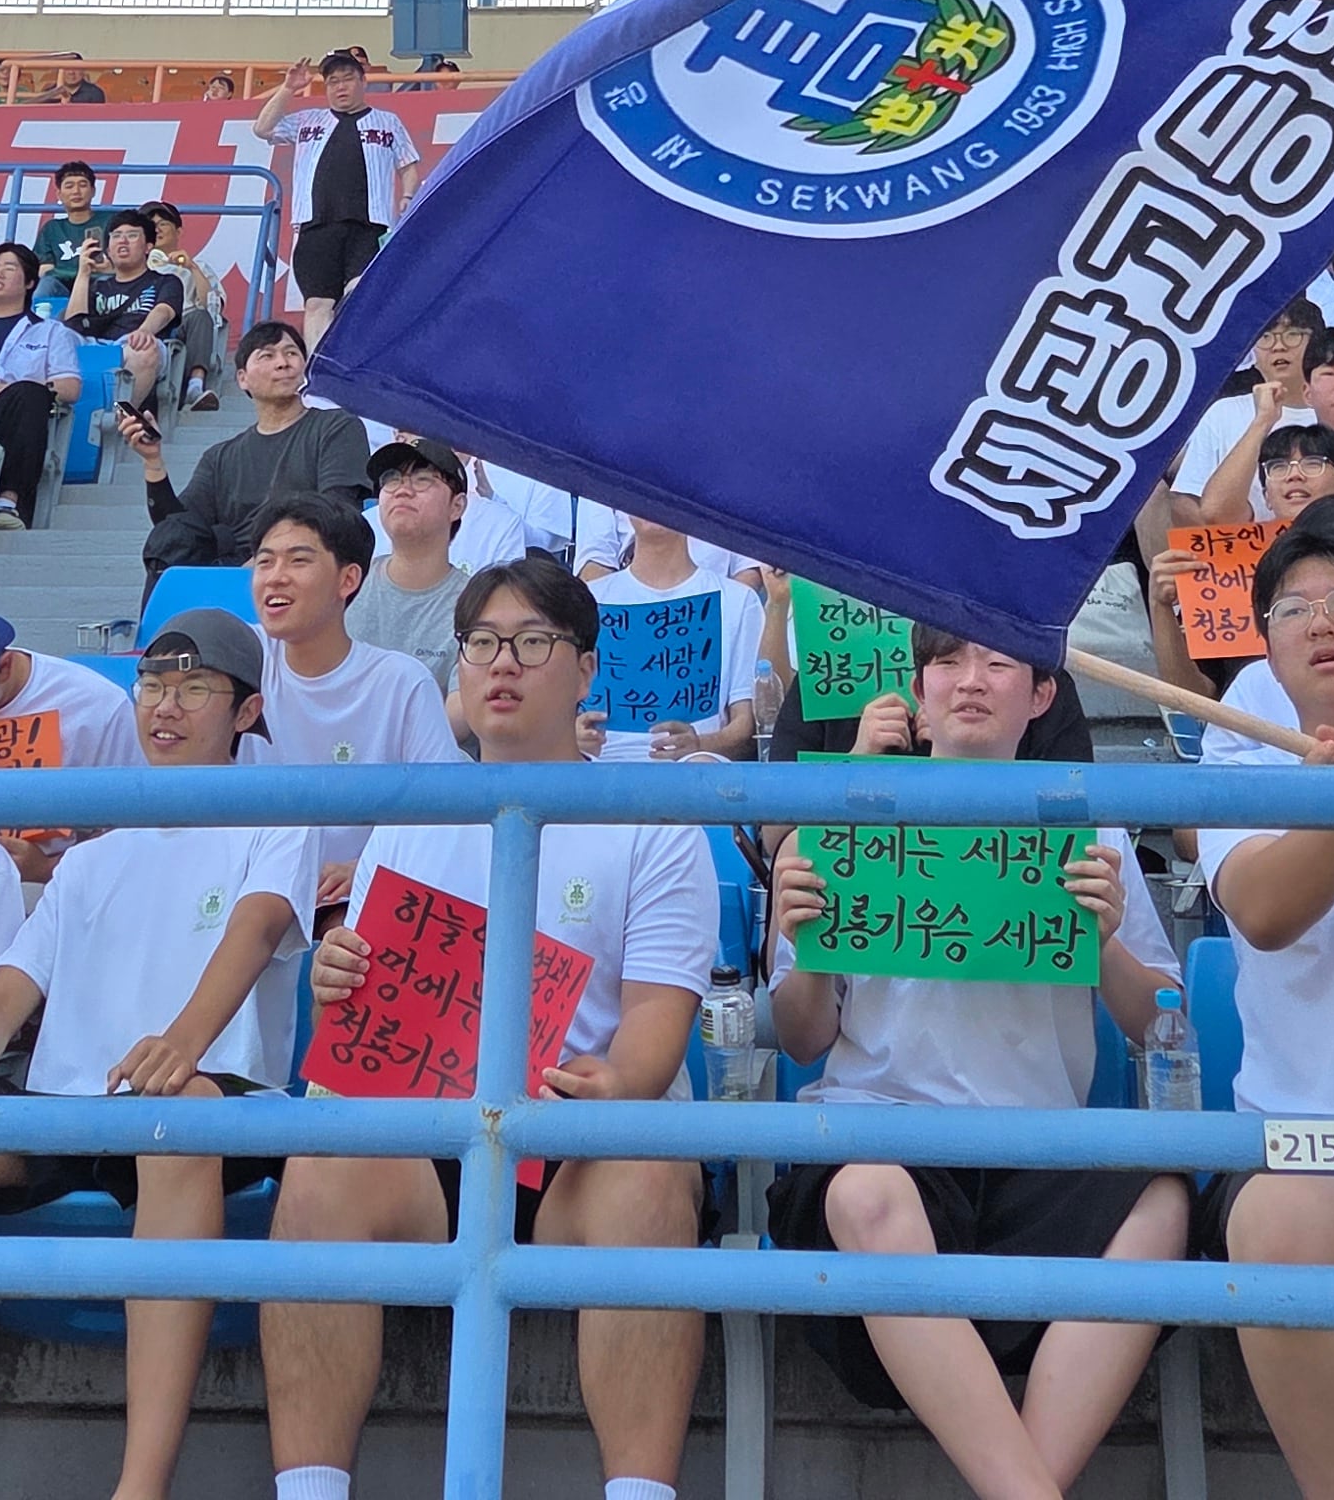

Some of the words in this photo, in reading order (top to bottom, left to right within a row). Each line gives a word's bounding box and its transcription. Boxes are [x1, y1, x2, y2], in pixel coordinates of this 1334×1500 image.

[754, 141, 1001, 214] SEKWANG
[1003, 83, 1067, 138] 1953
[1045, 16, 1090, 72] HIGH
[1189, 524, 1266, 557] 하늘엔
[645, 596, 712, 641] 영광!
[640, 637, 713, 680] 세광!
[819, 826, 946, 879] 땅에는
[960, 828, 1076, 888] 세광!
[982, 908, 1088, 970] 세광
[330, 1001, 478, 1098] 청룡기우
